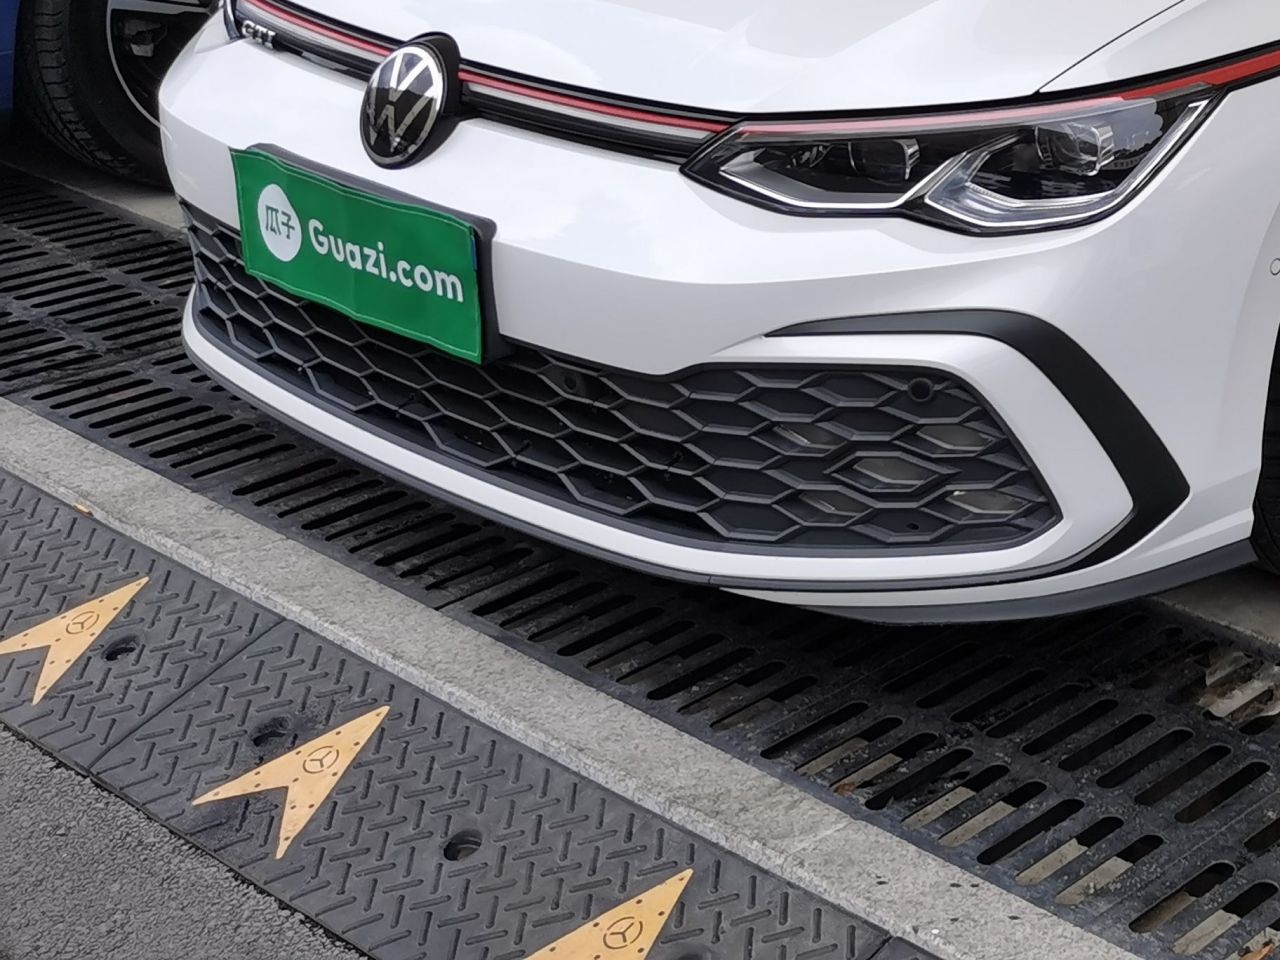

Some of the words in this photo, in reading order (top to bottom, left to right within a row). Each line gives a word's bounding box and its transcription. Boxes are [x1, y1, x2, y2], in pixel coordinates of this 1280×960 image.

[242, 20, 276, 48] GTI
[265, 204, 296, 240] 瓜子
[308, 218, 464, 303] Guazi.com
